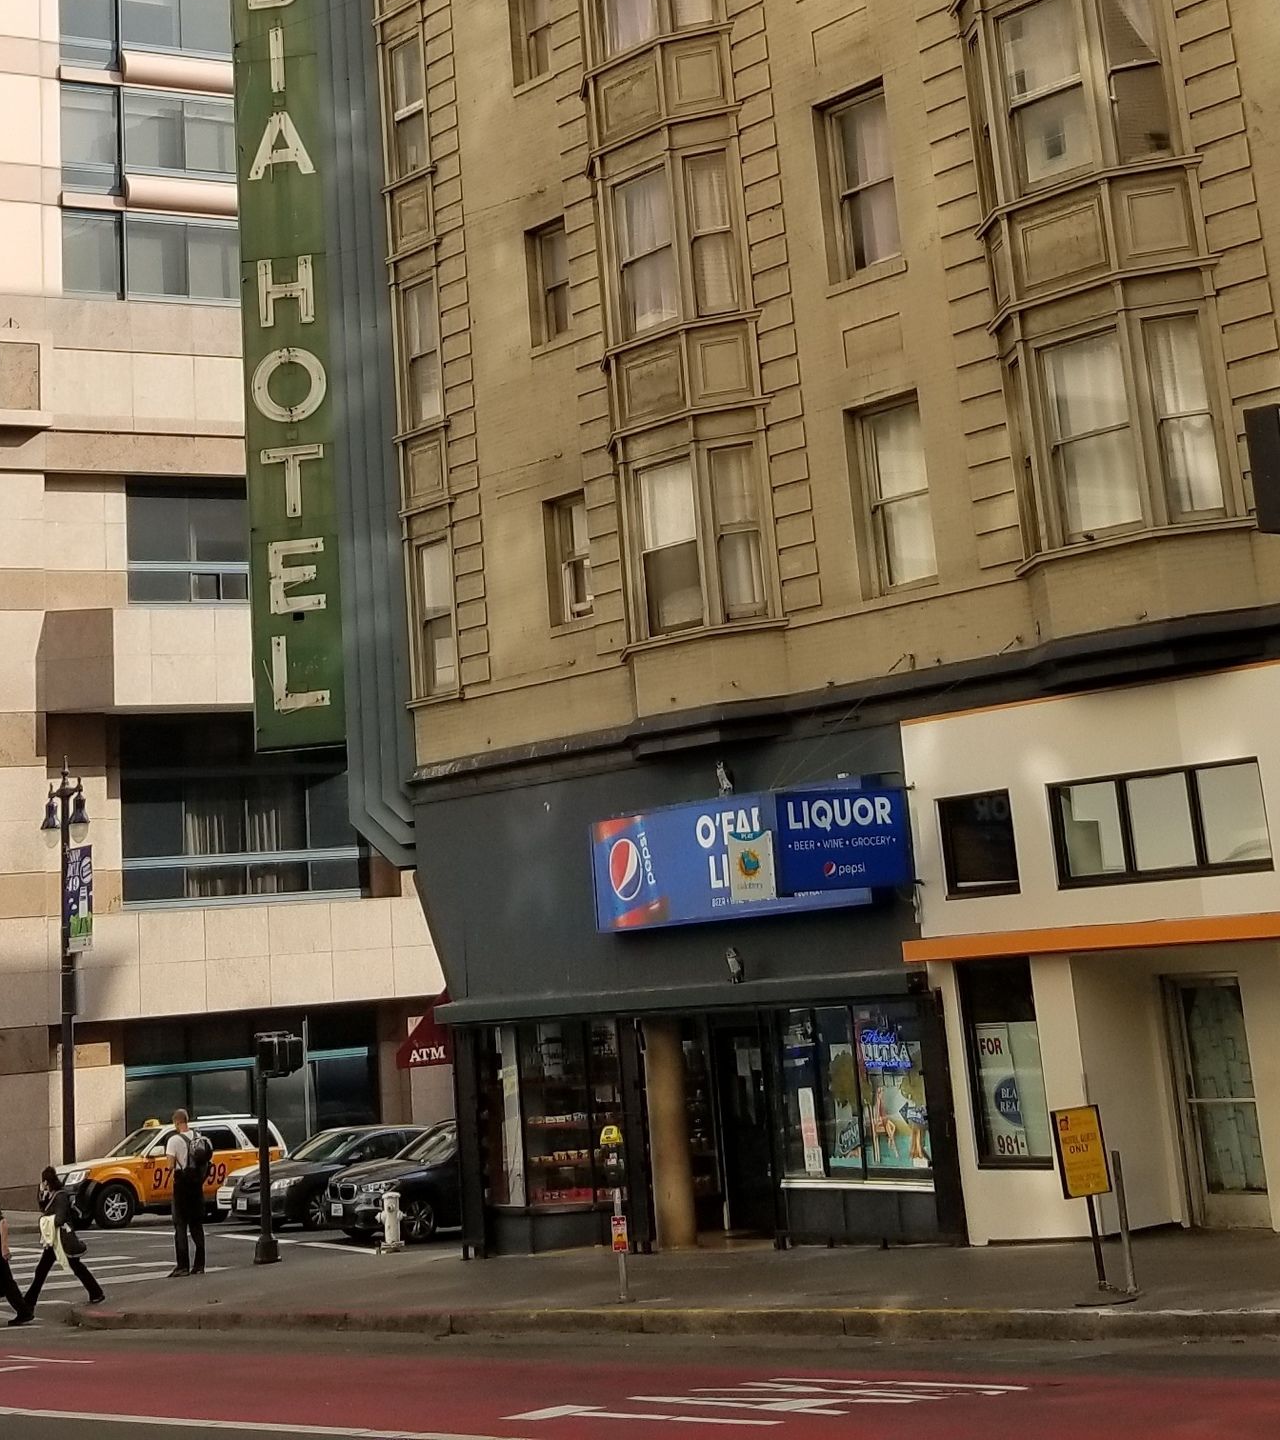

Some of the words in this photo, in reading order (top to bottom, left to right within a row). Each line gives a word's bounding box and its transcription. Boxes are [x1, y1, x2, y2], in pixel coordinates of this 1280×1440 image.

[254, 254, 331, 713] HOTEL
[787, 796, 892, 831] LIQUOR
[794, 841, 815, 851] BEER
[822, 838, 844, 848] WINE
[851, 836, 890, 847] GROCERY
[637, 832, 656, 885] pepsi
[838, 862, 865, 876] pepsi
[409, 1045, 446, 1063] ATM
[861, 1043, 910, 1062] ULTRA
[979, 1037, 1003, 1056] FOR
[1069, 1143, 1089, 1154] ONLY
